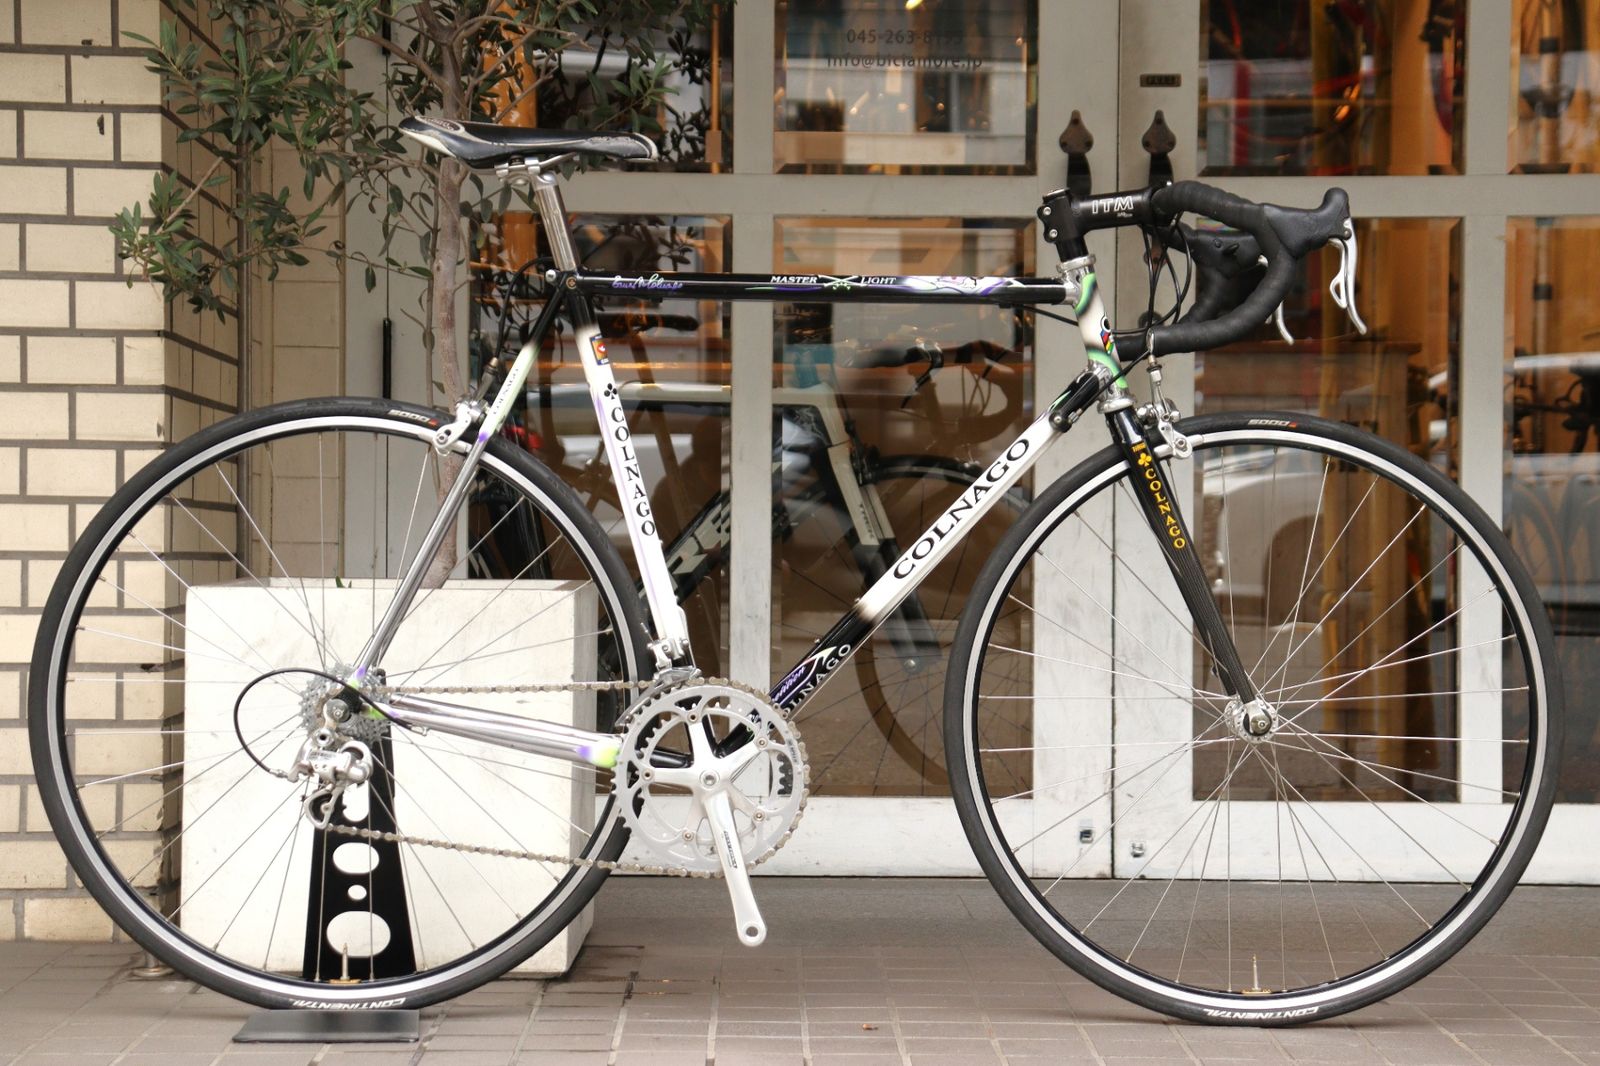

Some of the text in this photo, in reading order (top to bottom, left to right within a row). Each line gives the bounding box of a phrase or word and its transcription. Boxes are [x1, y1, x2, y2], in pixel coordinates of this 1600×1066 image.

[1092, 195, 1134, 214] ITM
[770, 275, 818, 284] MASTER
[861, 276, 897, 285] LIGHT
[611, 406, 656, 537] COLNAGO
[893, 438, 1030, 579] COLNAGO
[1145, 468, 1186, 549] COLNAGO
[783, 644, 851, 714] LNAGO
[289, 997, 406, 1010] CONTINENTAL
[1202, 1006, 1319, 1019] CONTINENTAL
